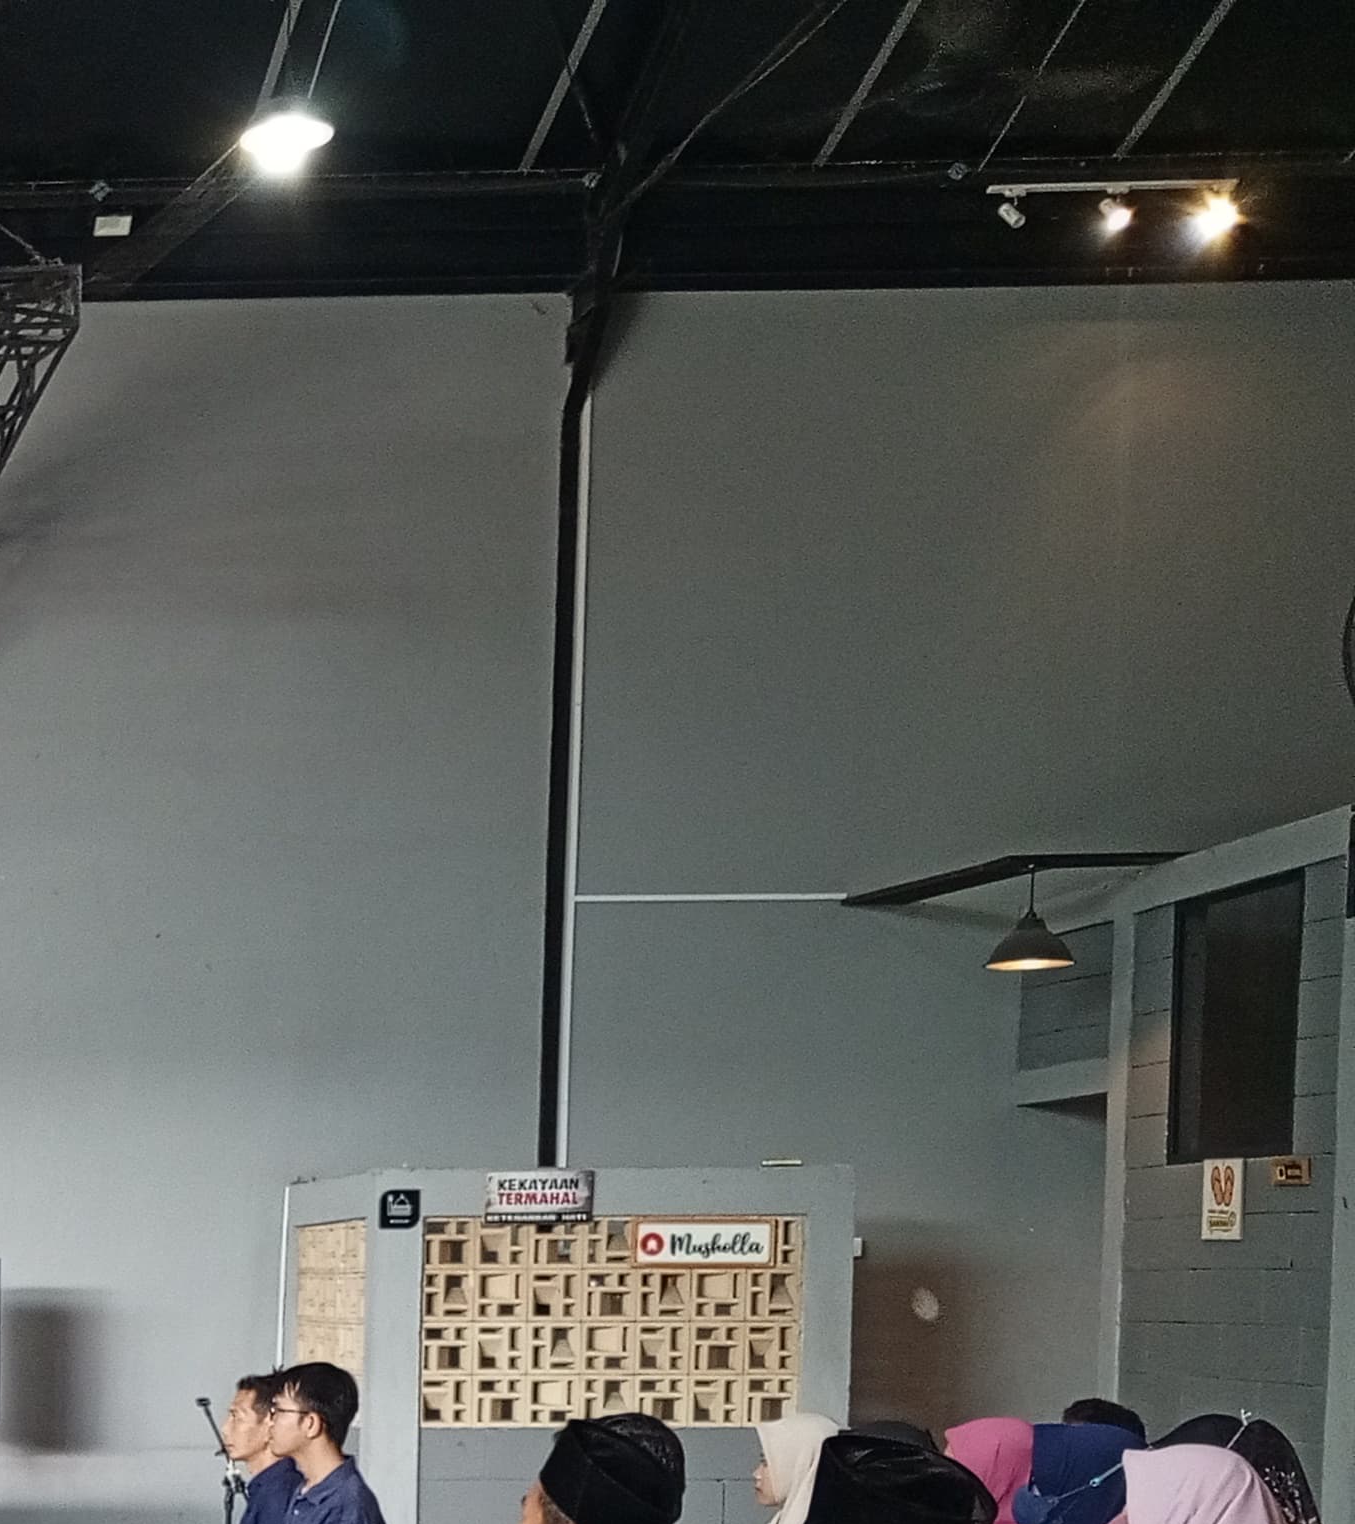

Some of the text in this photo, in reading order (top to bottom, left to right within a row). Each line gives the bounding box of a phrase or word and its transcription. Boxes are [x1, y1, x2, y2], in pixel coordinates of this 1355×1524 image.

[497, 1178, 580, 1191] KEKAYAAN
[497, 1192, 579, 1206] TERMAHAL
[670, 1231, 764, 1258] Musholla
